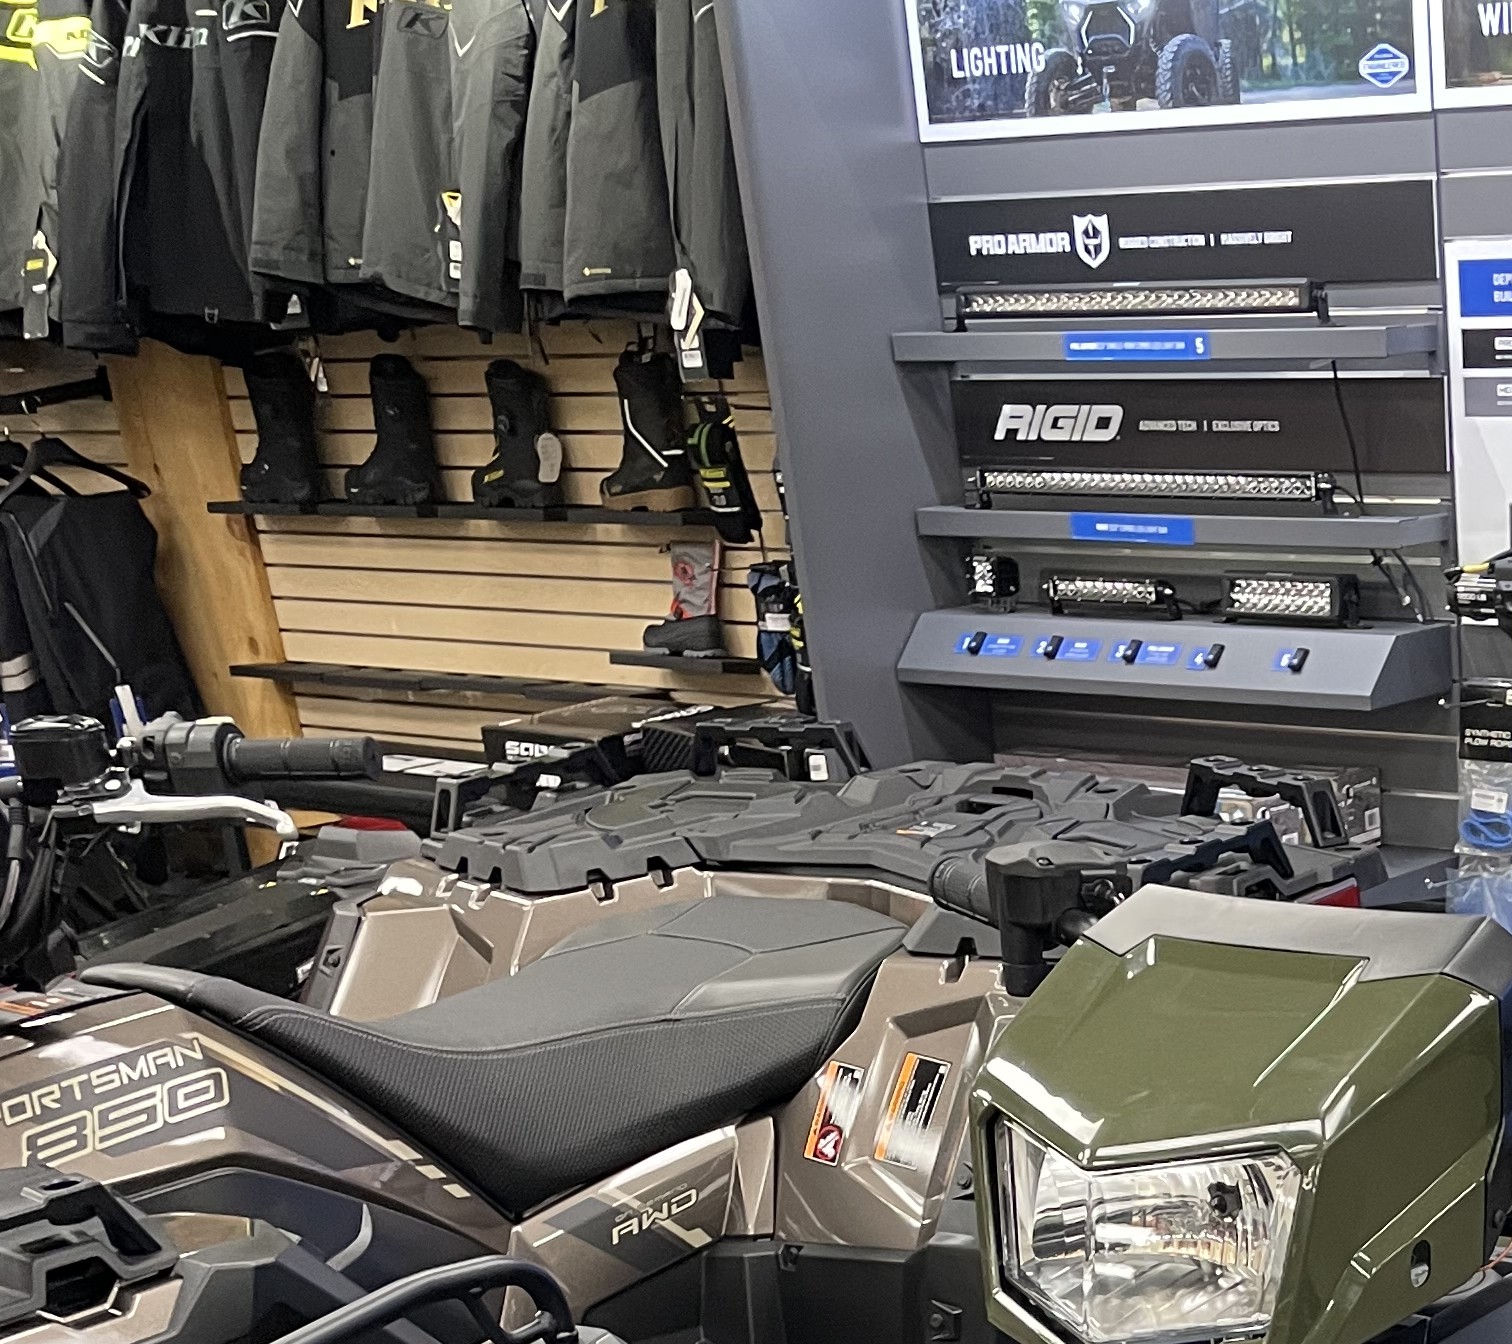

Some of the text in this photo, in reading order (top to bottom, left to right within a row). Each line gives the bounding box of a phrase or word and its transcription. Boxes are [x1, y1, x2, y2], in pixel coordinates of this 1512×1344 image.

[951, 42, 1046, 78] LIGHTING
[993, 404, 1123, 442] RIGID
[0, 1038, 204, 1127] ORTSMAN
[21, 1067, 231, 1168] 850
[611, 1188, 698, 1246] AWD
